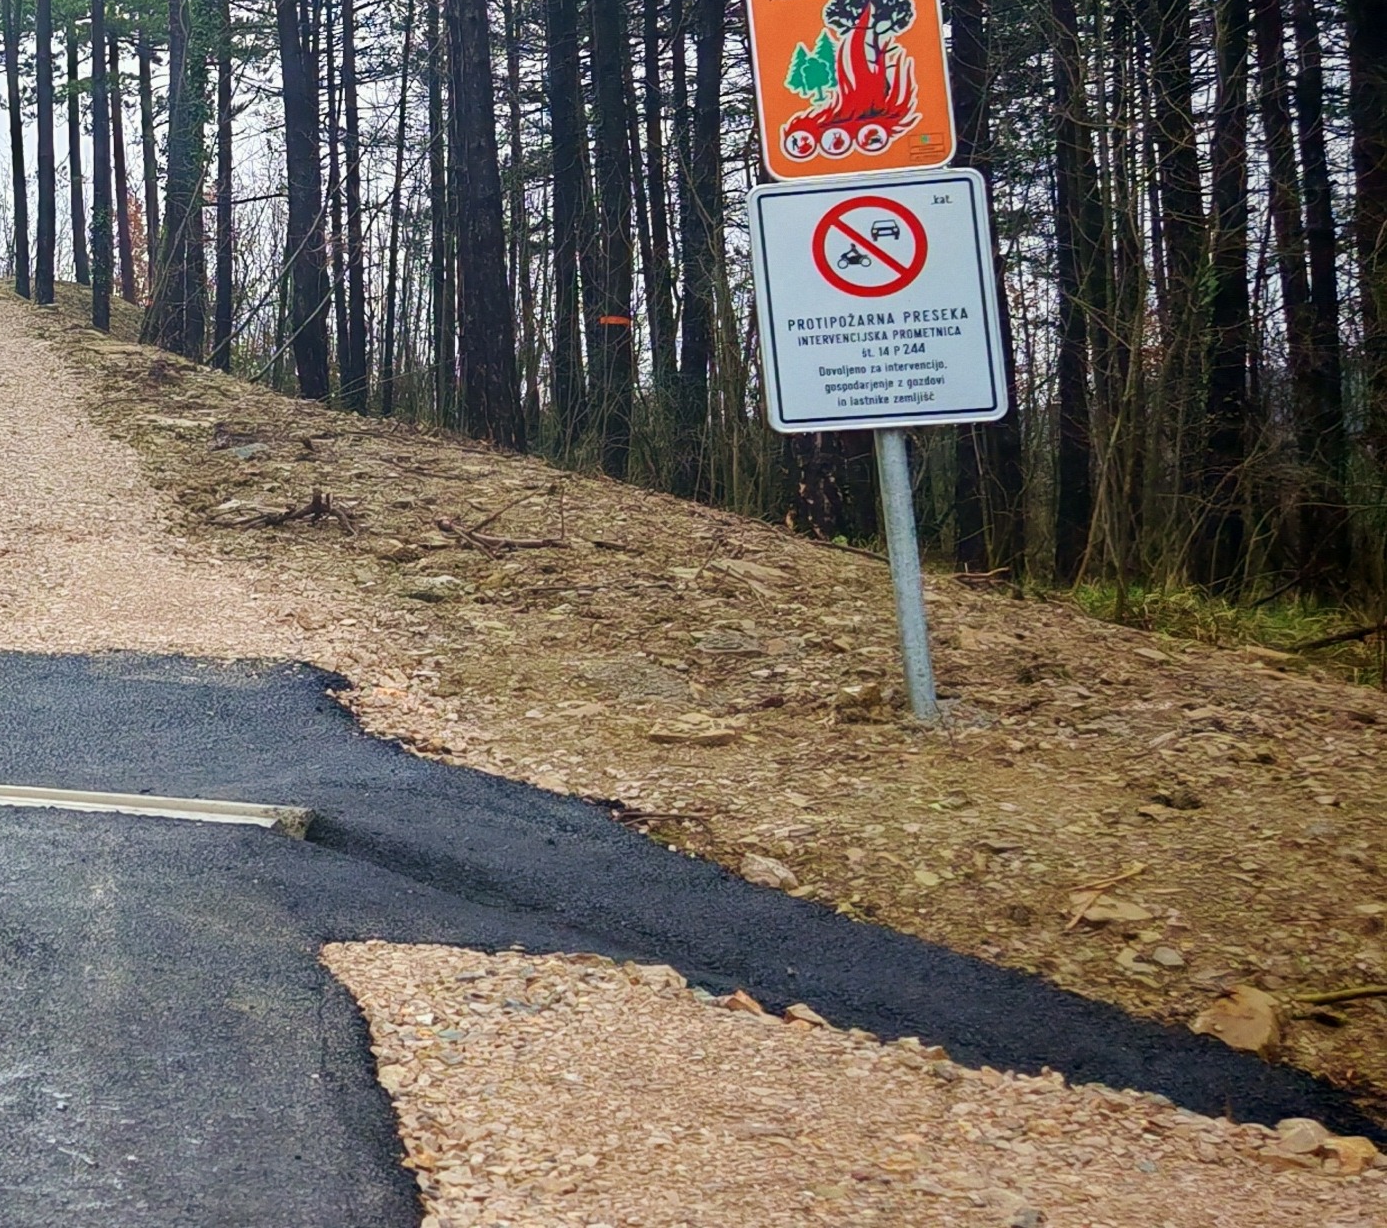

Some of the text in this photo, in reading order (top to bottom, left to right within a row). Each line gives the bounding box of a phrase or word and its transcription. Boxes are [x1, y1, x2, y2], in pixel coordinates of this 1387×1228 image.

[788, 307, 969, 331] PROTIPOŽARNA PRESEKA
[798, 326, 961, 347] INTERVENCIJSKA PROMETNICA
[879, 347, 889, 356] 14
[894, 345, 900, 355] P
[903, 343, 926, 354] 244
[819, 365, 866, 378] Dovoljeno
[871, 365, 882, 373] za
[825, 379, 893, 393] gospodarjenje
[907, 375, 945, 389] gozdovi
[838, 392, 935, 406] in lastnike zemljišč
